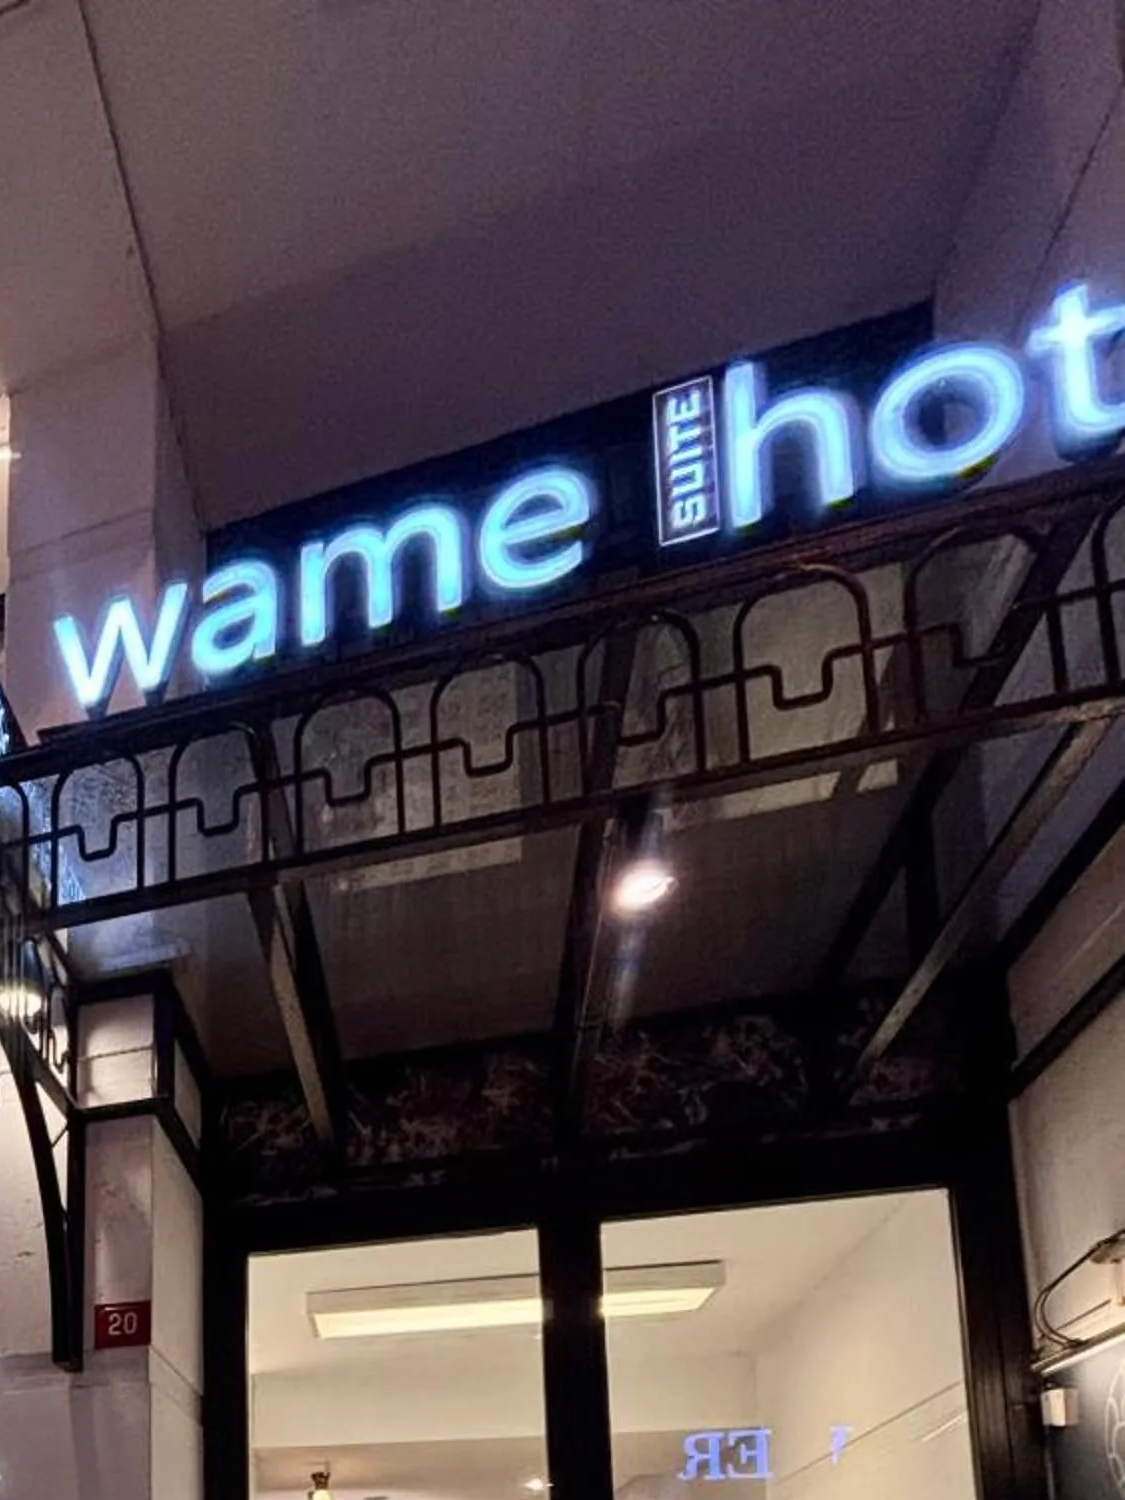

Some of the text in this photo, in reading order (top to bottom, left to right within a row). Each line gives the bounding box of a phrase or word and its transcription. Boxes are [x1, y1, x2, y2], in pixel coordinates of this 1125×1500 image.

[53, 462, 591, 709] wame
[667, 388, 707, 530] SUITE
[108, 1312, 138, 1335] 20
